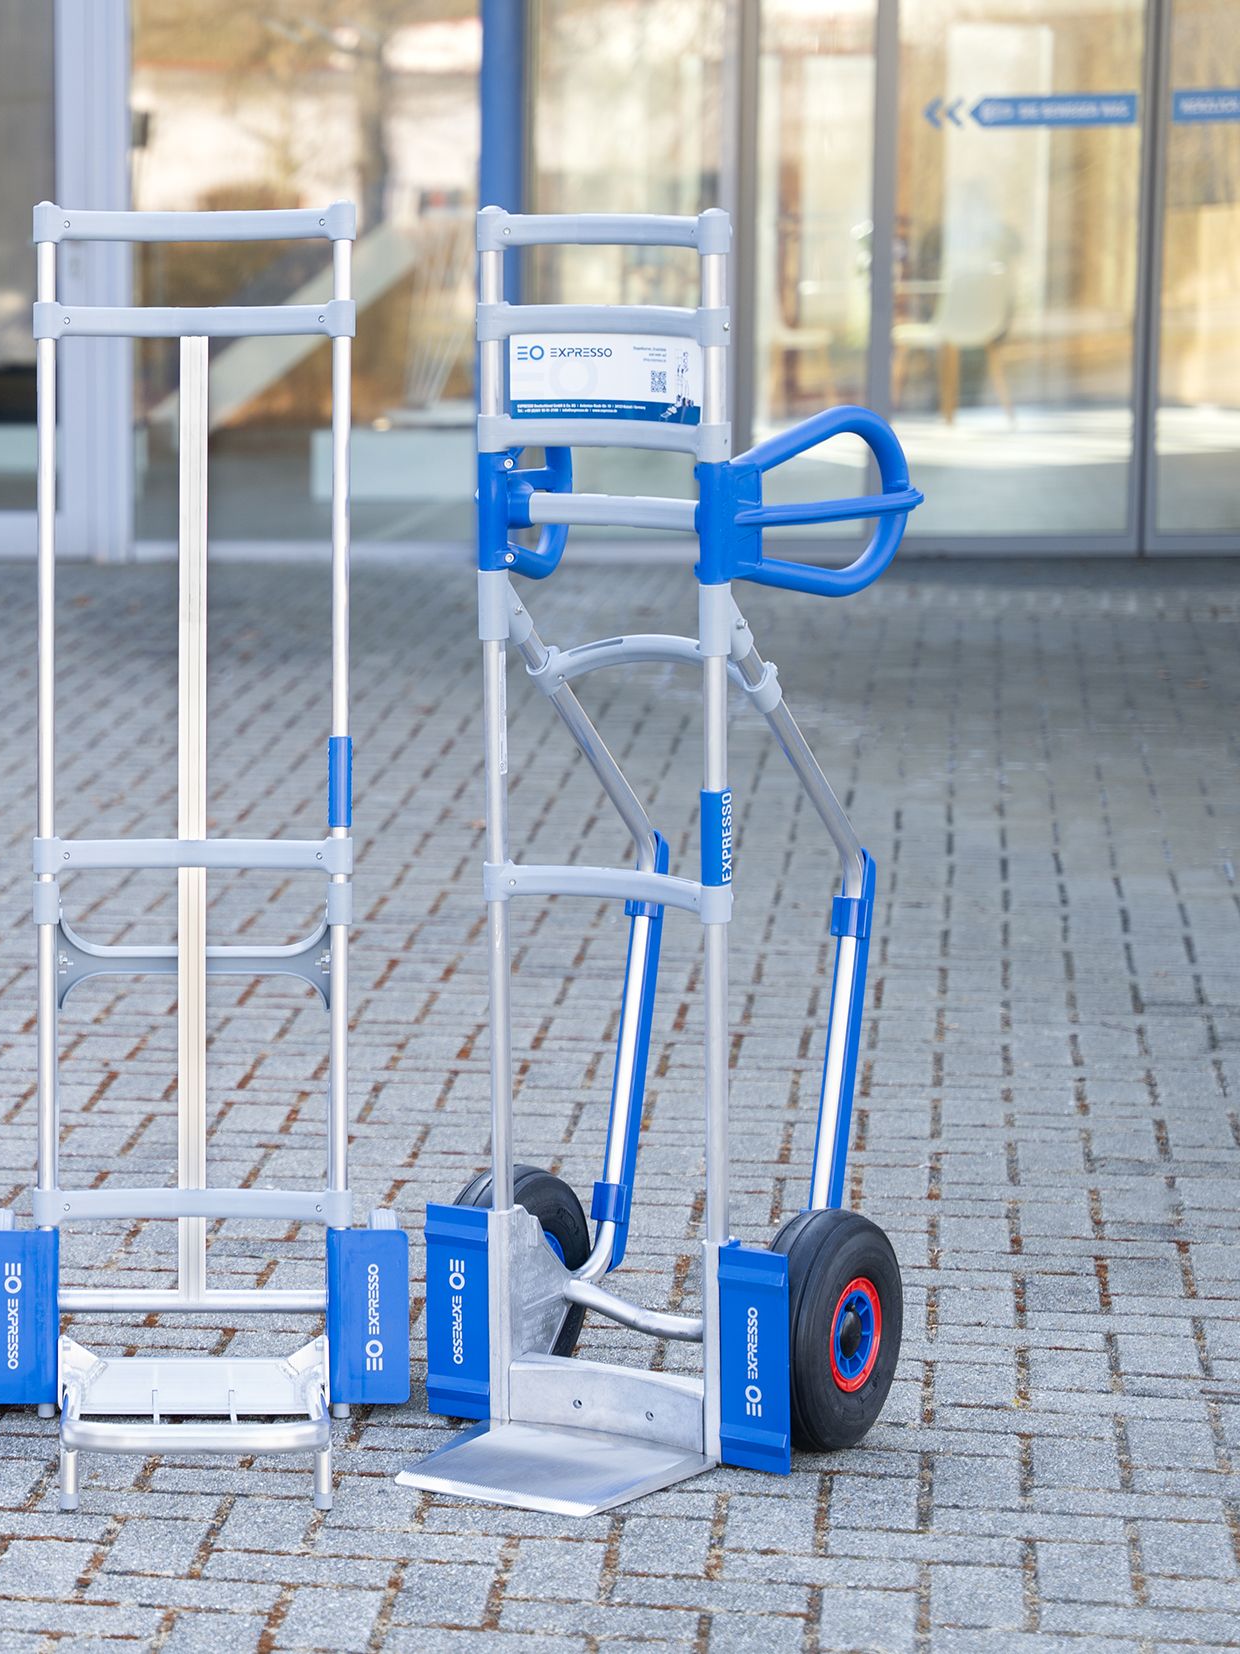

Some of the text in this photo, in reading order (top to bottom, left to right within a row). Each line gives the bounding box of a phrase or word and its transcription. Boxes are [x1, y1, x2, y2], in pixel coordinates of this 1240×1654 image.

[550, 347, 613, 358] EXPRESSO
[721, 791, 732, 883] EXPRESSO
[7, 1298, 19, 1370] EXPRESSO
[367, 1263, 380, 1335] EXPRESSO
[451, 1295, 464, 1365] EXPRESSO
[747, 1307, 759, 1380] EXPRESSO
